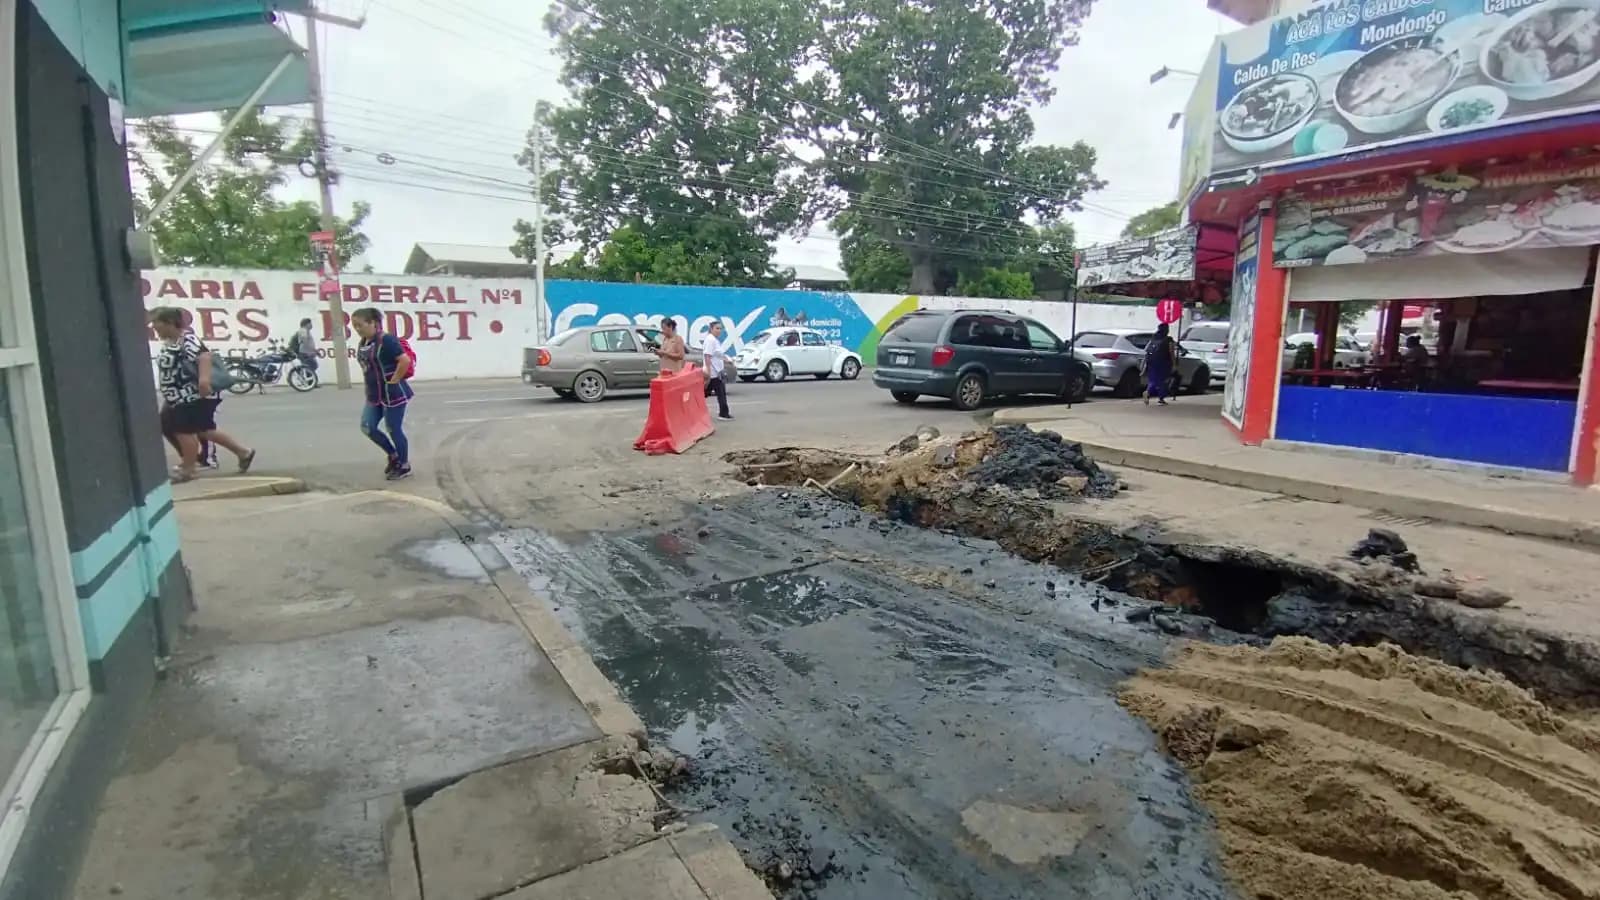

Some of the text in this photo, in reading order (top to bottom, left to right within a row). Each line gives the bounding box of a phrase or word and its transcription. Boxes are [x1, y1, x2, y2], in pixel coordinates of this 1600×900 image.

[1324, 4, 1361, 33] LOS
[1360, 9, 1446, 45] Mondongo
[1234, 52, 1317, 86] Caldo De Res
[319, 310, 477, 342] BDET
